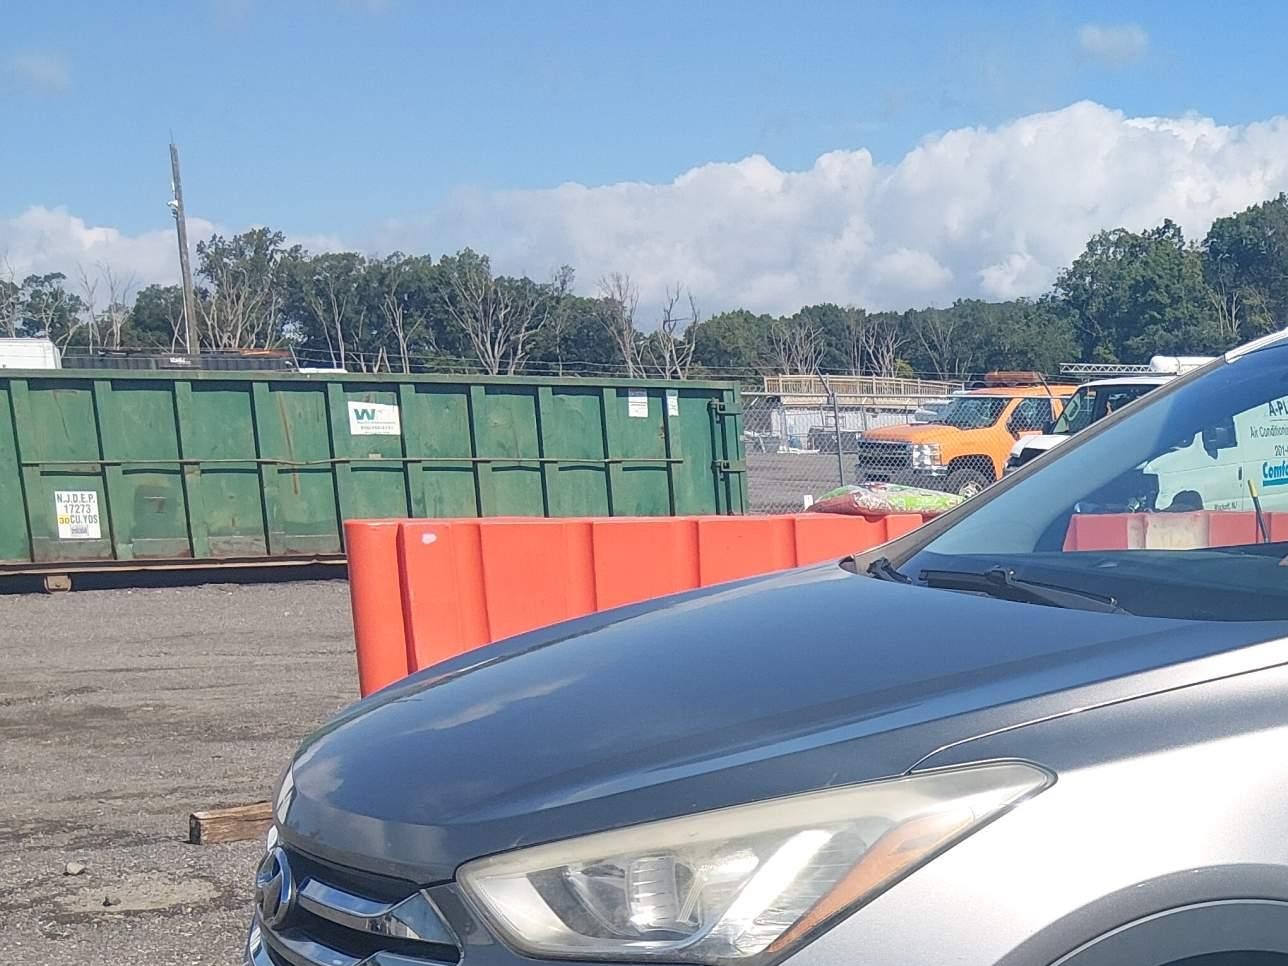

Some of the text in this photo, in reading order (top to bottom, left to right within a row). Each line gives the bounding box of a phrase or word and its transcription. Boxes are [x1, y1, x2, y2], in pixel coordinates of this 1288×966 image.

[1250, 426, 1259, 438] Air
[56, 493, 96, 504] N.J.D.E.P.
[64, 503, 92, 514] 17273
